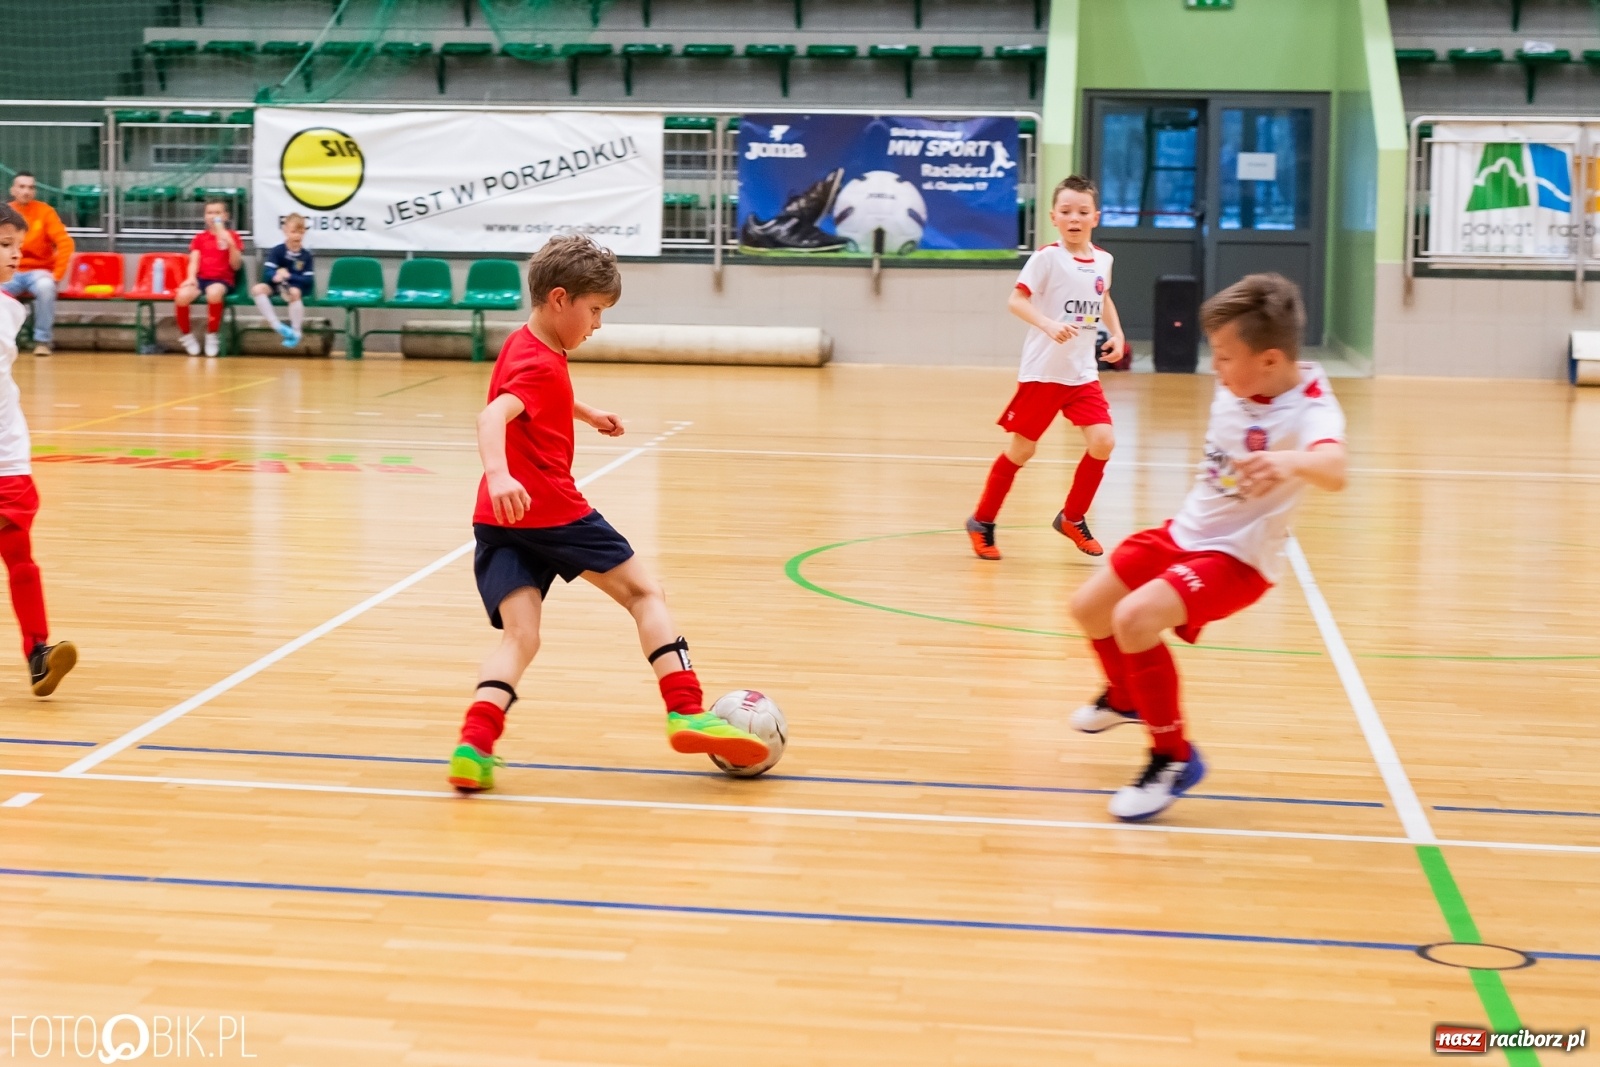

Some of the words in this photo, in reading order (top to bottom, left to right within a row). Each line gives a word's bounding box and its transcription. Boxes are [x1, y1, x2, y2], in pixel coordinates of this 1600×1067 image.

[886, 139, 924, 157] MW
[925, 140, 991, 157] SPORT
[384, 191, 443, 225] JEST
[450, 182, 475, 204] W
[482, 136, 638, 196] PORZĄDKU!
[278, 212, 367, 231] RCIBÓRZ
